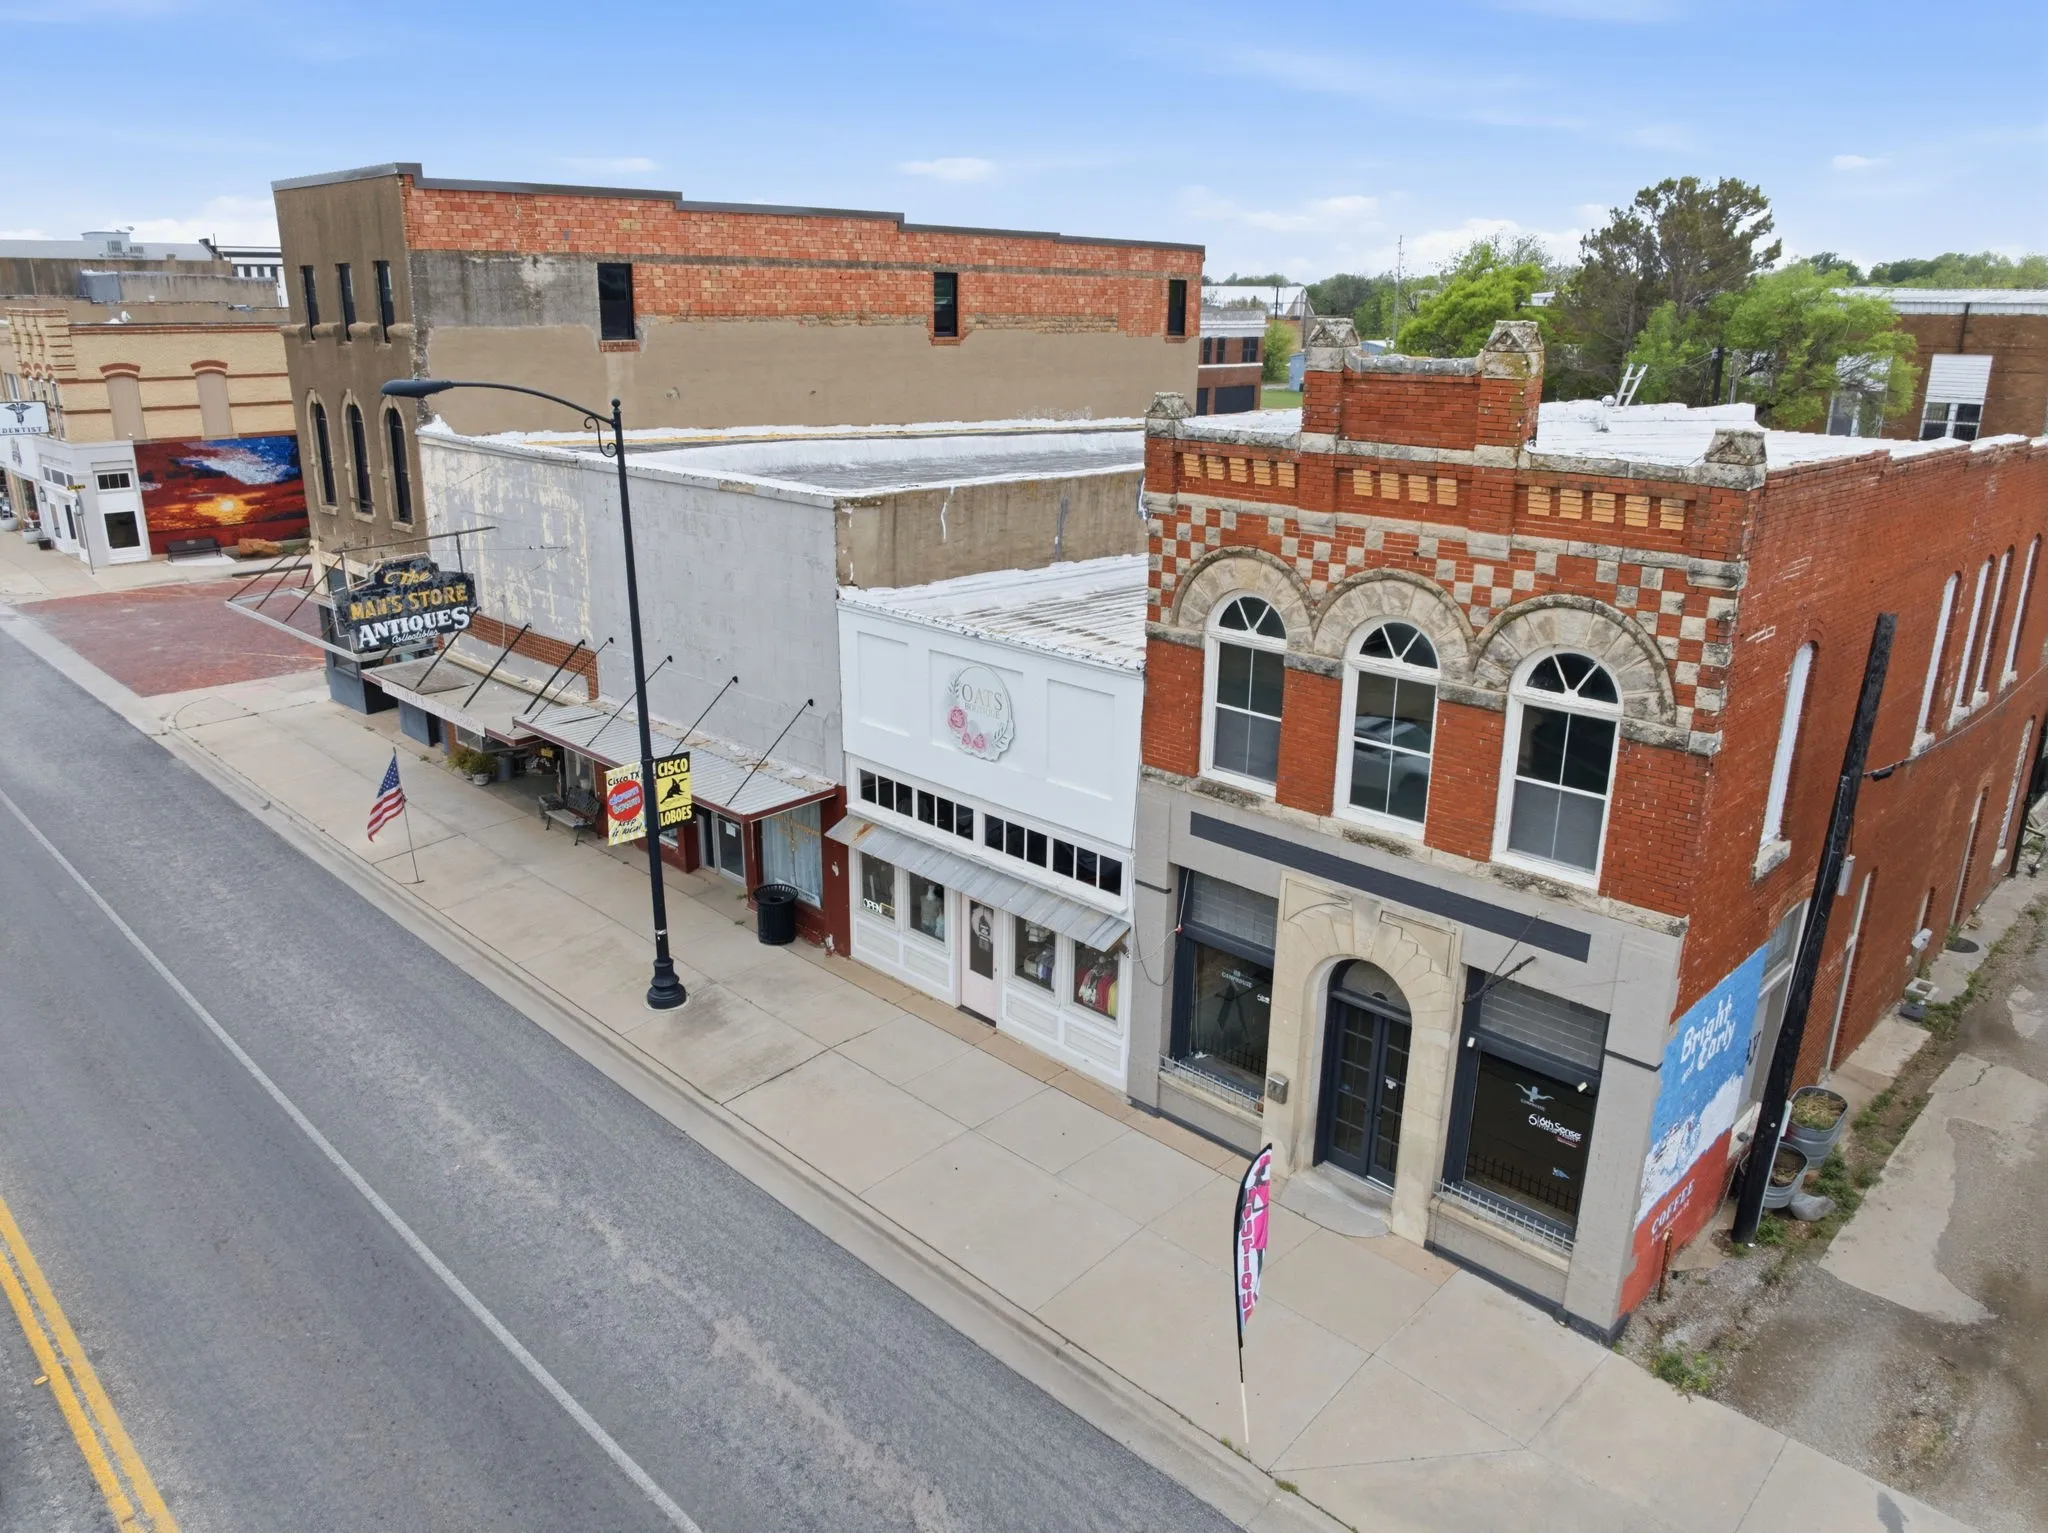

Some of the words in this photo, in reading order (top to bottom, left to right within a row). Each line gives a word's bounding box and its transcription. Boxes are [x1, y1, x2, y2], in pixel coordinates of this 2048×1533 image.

[384, 569, 433, 585] The
[408, 584, 469, 610] STORE
[358, 606, 470, 649] ANTIQUES
[391, 628, 441, 644] Collectibles
[961, 683, 1002, 711] OATS
[657, 757, 688, 777] CISCO
[660, 805, 692, 827] LOBOES
[863, 898, 882, 914] OPEN
[1680, 994, 1733, 1064] Bright
[1697, 1020, 1736, 1071] Early
[1554, 1122, 1582, 1140] Sense
[1651, 1178, 1695, 1234] COFFEE
